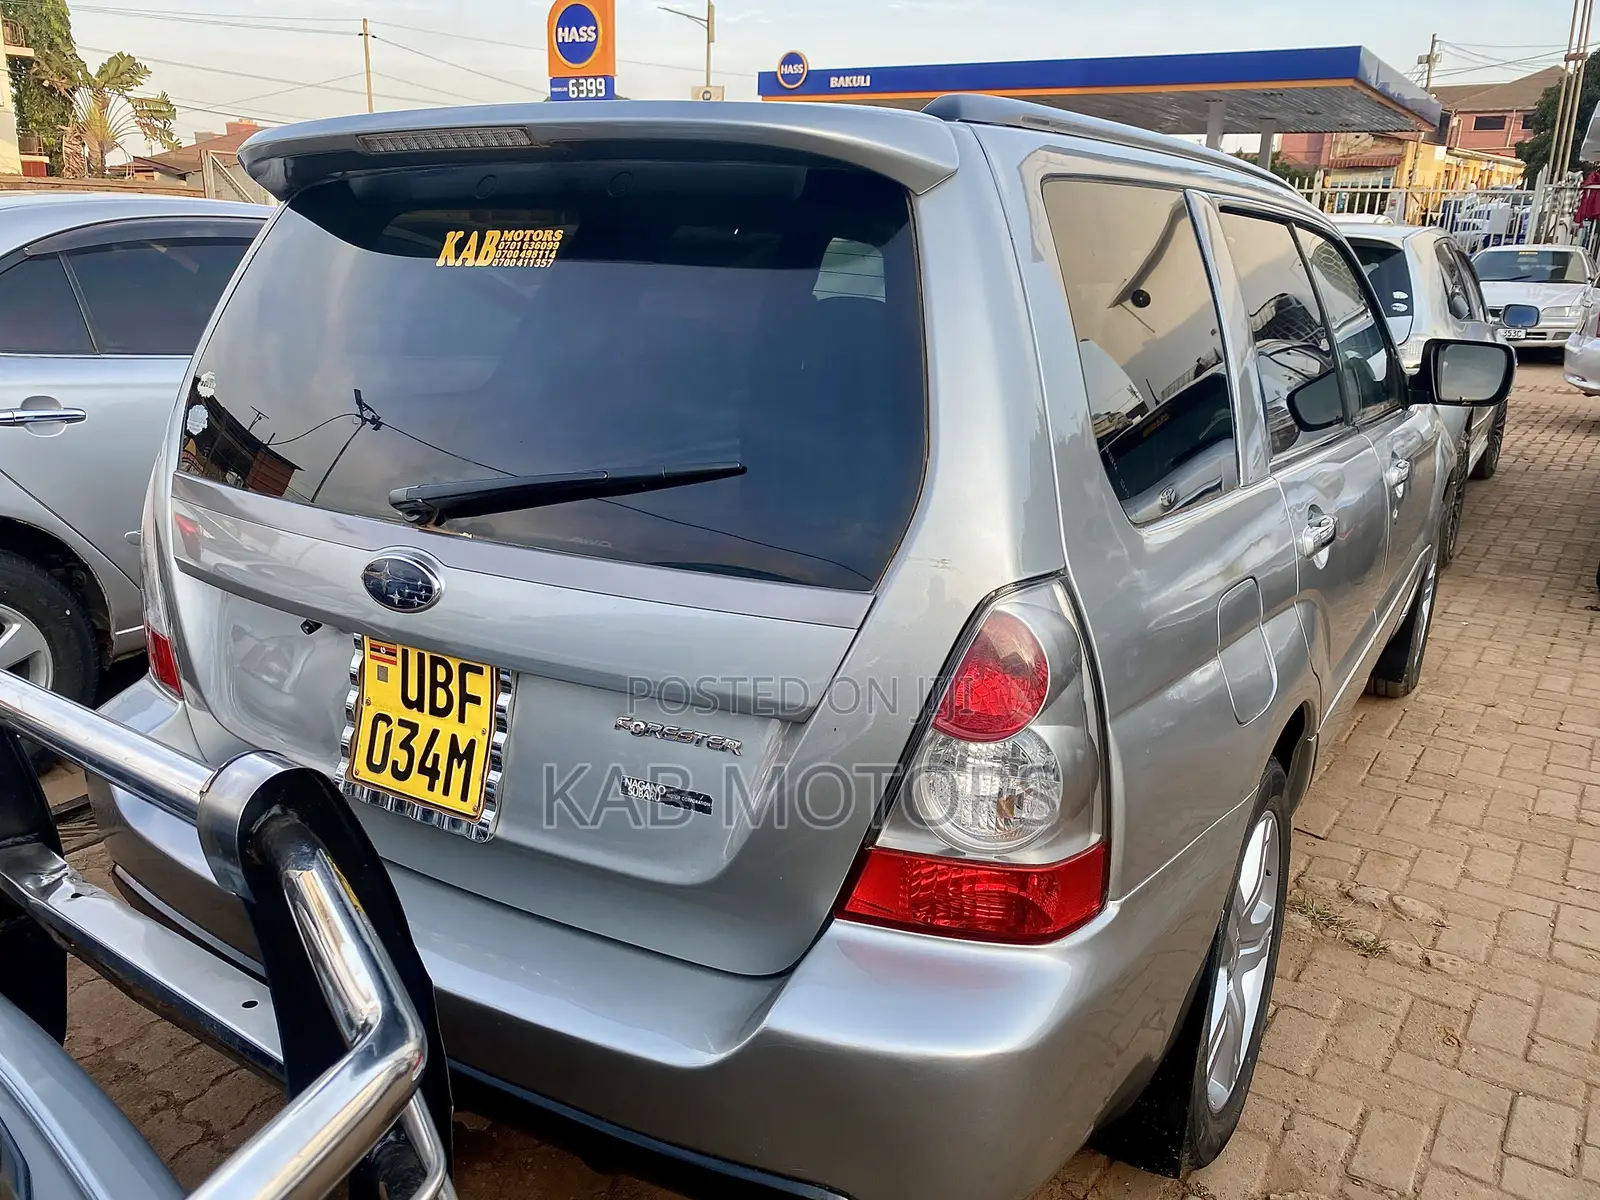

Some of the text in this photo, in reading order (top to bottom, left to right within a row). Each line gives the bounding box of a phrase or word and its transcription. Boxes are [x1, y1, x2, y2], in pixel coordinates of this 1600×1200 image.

[557, 25, 597, 43] HASS
[780, 63, 804, 75] HASS
[568, 78, 606, 98] 6399
[829, 75, 871, 88] BAKULI
[500, 229, 564, 242] MOTORS
[435, 230, 501, 267] KAB
[498, 241, 560, 250] 0701 636099
[491, 258, 554, 268] 0700 411357
[495, 250, 556, 259] 0700 498114
[400, 647, 484, 724] UBF
[613, 715, 743, 757] FORESTER
[365, 712, 477, 803] 034M
[624, 778, 666, 795] NAGANO
[627, 785, 661, 803] SUBARU
